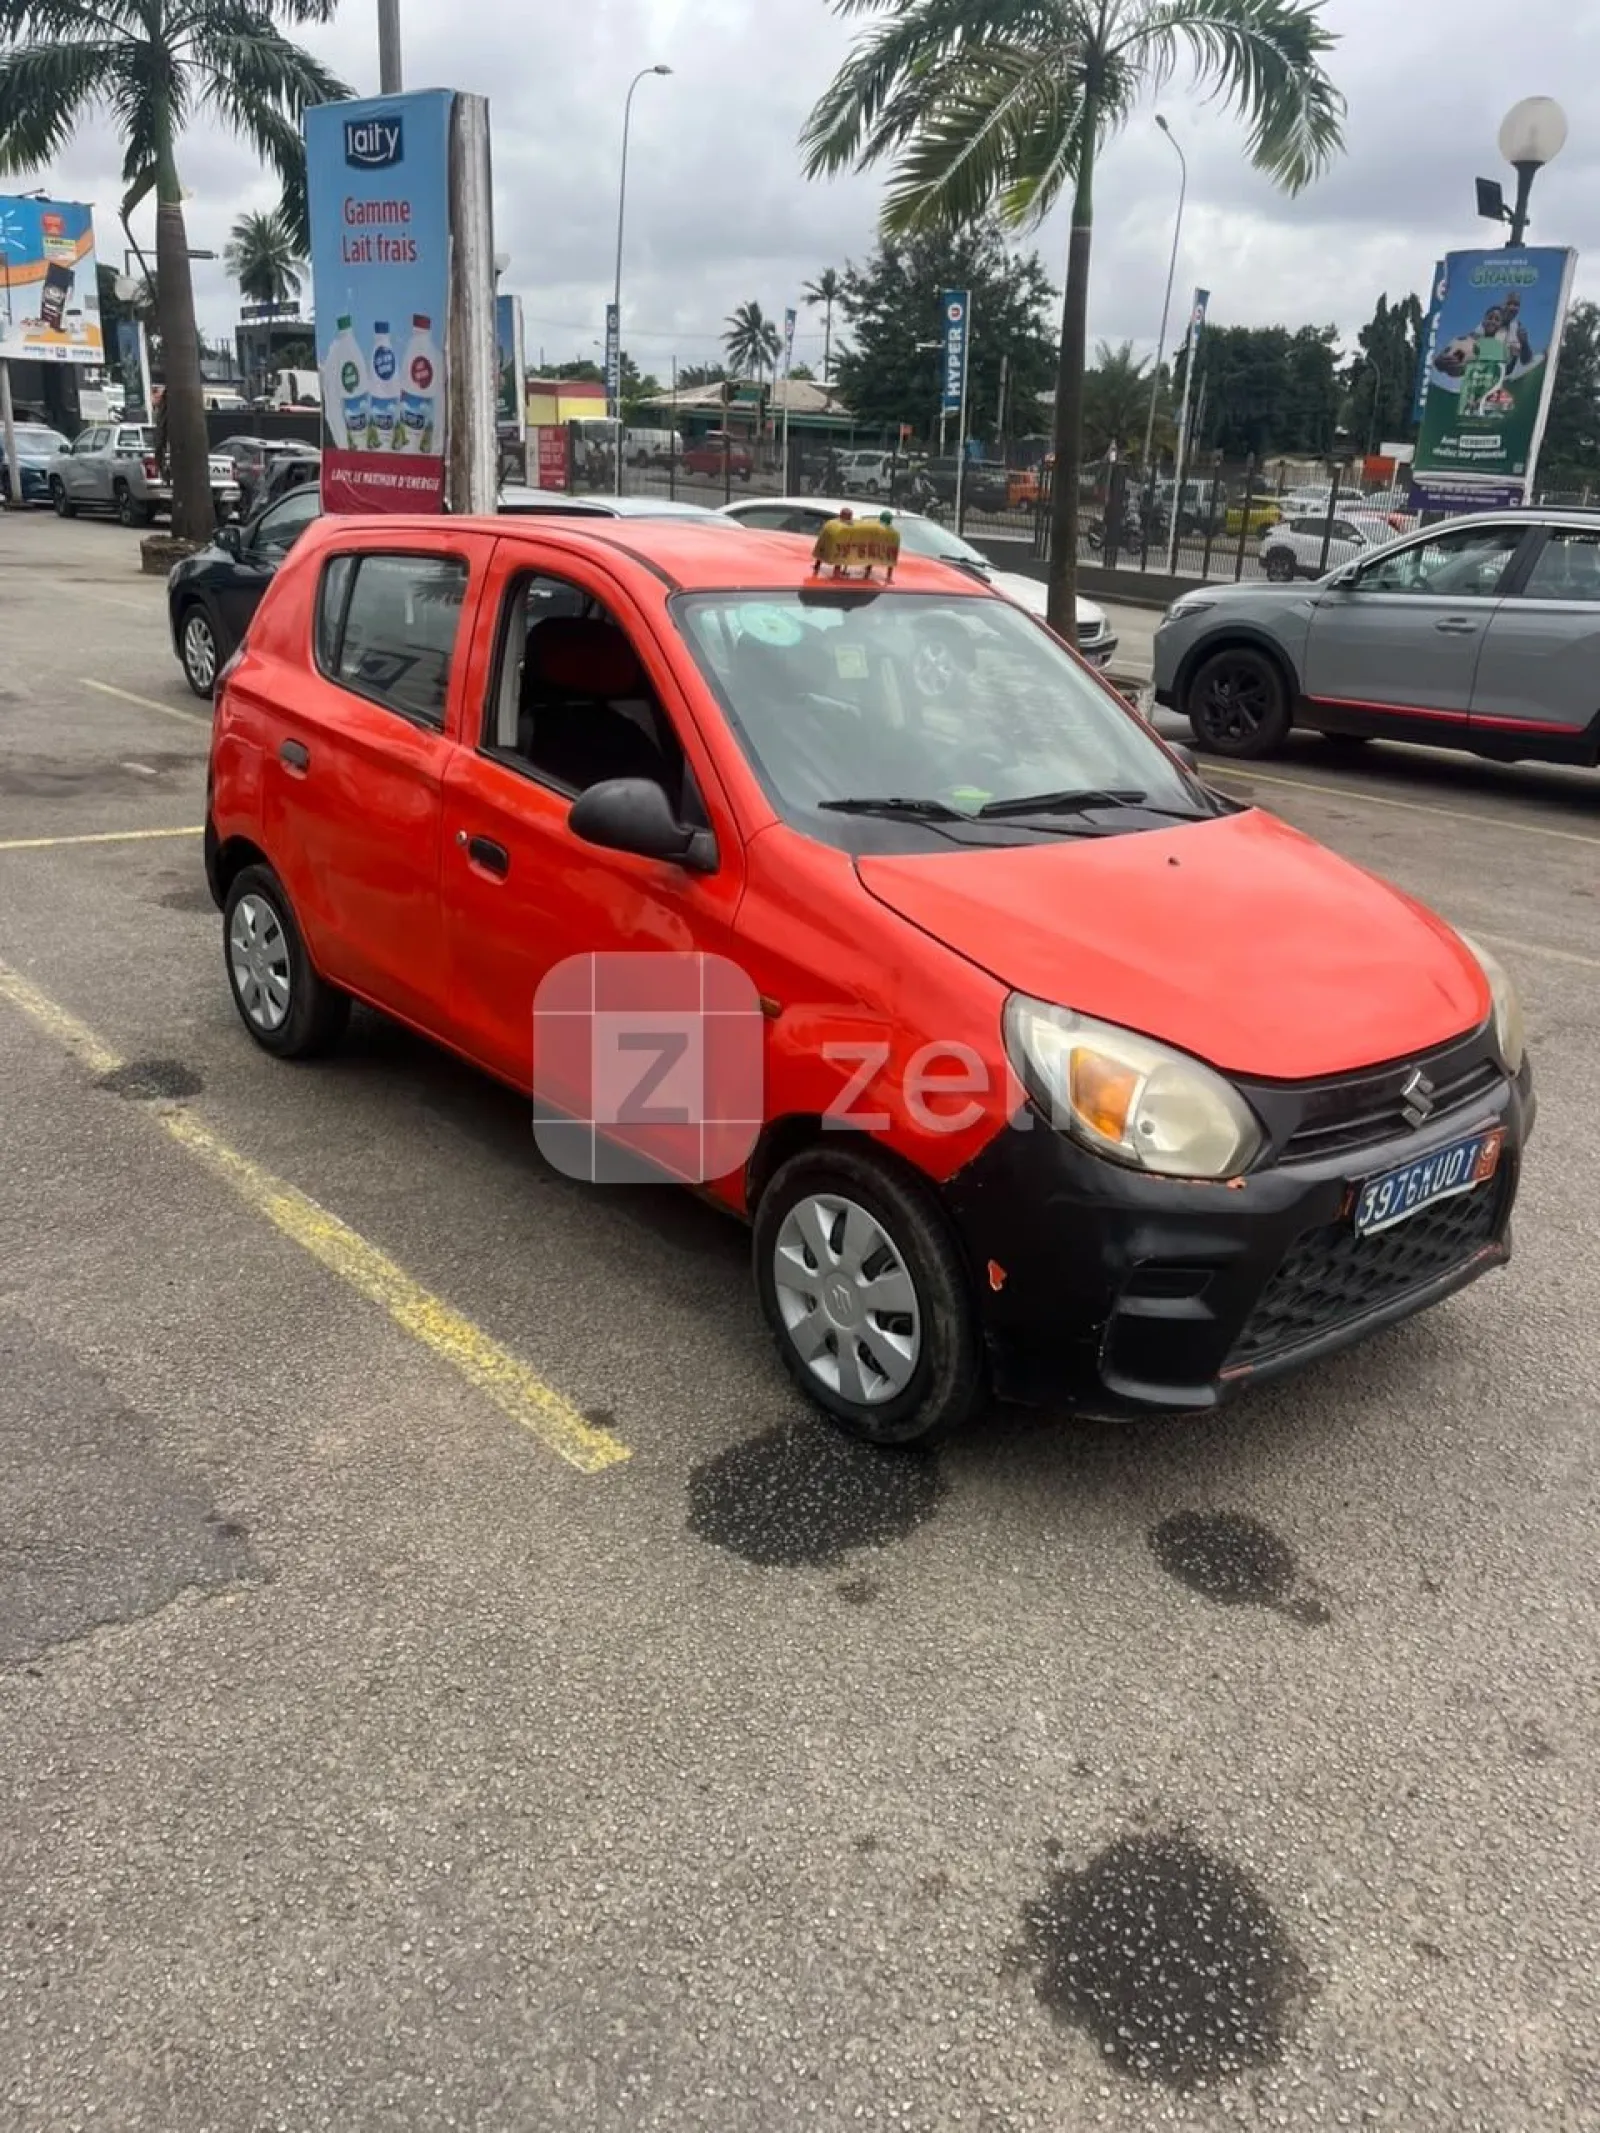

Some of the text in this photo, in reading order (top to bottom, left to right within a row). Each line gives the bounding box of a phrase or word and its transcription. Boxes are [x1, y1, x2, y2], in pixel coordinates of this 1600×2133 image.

[344, 196, 411, 225] Gamme
[342, 233, 418, 263] Lait frais
[948, 327, 962, 396] HYPER
